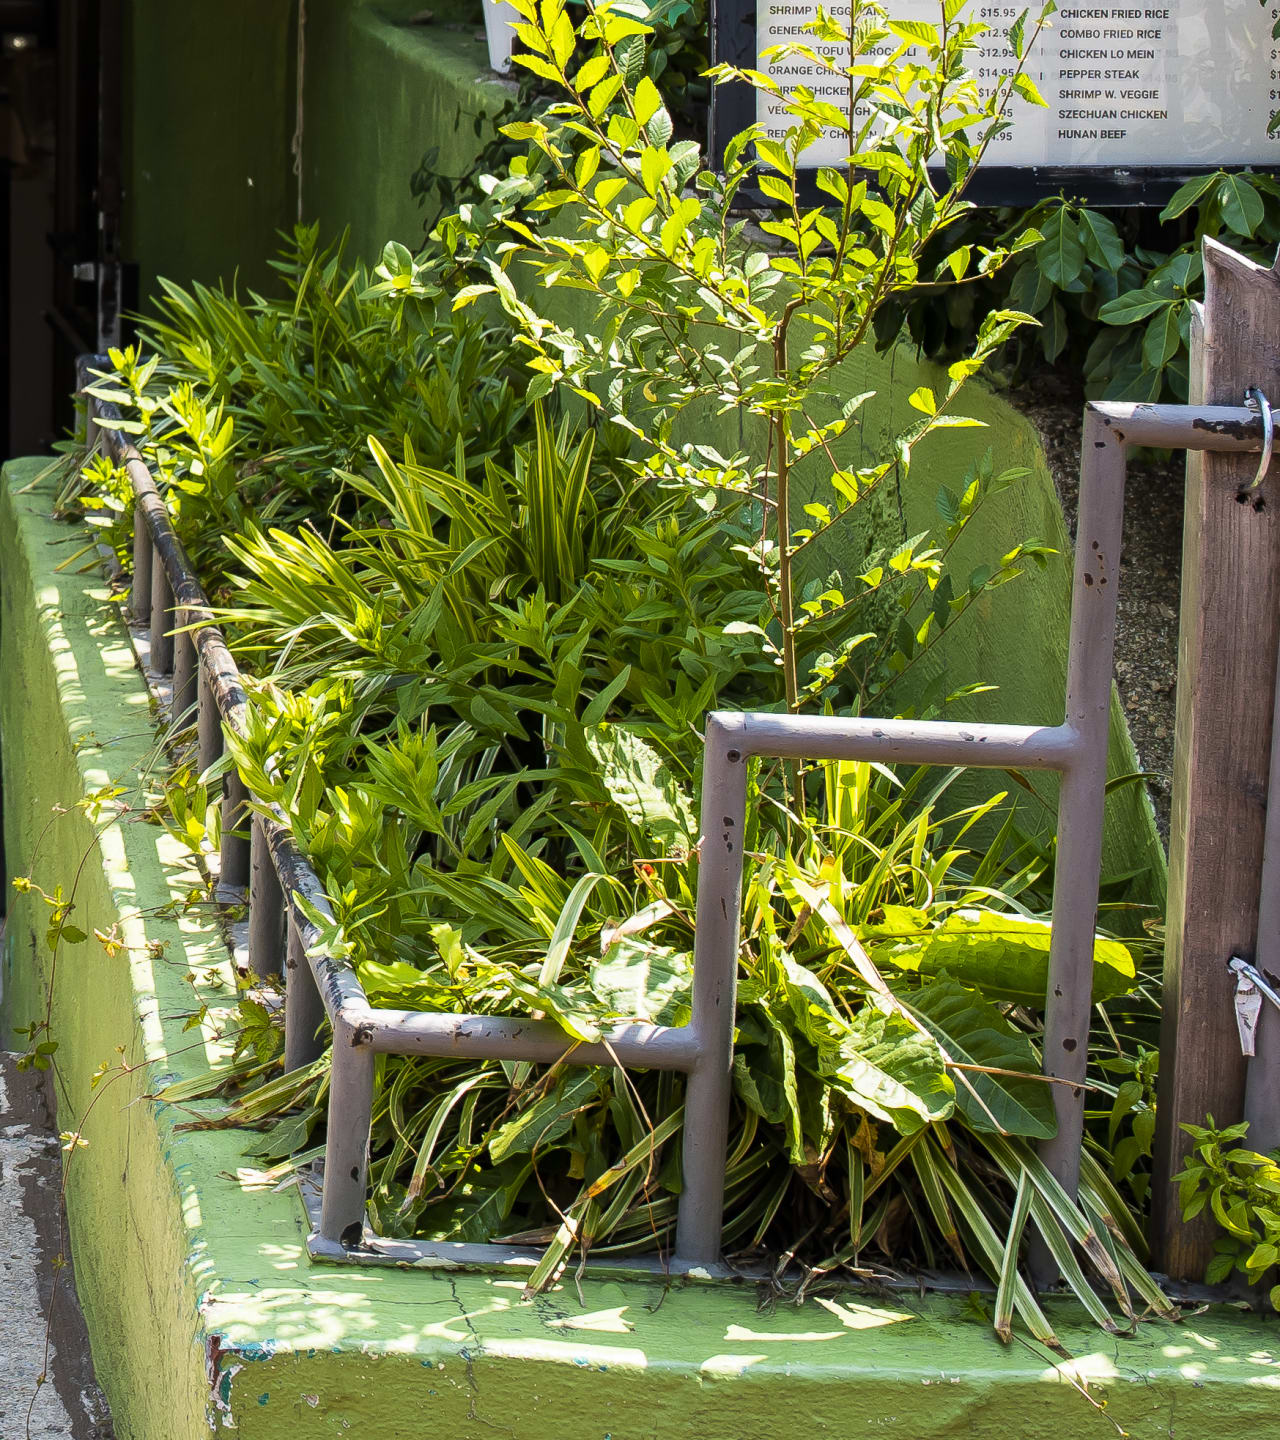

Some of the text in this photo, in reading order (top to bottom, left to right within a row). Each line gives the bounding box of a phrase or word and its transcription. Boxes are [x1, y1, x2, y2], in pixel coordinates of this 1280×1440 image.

[770, 6, 812, 15] SHRIMP
[980, 8, 1016, 18] $15.95
[1060, 10, 1169, 19] CHICKEN FRIED RICE
[1060, 30, 1161, 39] COMBO FRIED RICE
[816, 46, 844, 55] TOFU
[1060, 50, 1155, 59] CHICKEN LO MEIN
[768, 66, 813, 75] ORANGE
[979, 67, 1014, 77] $14.95
[1059, 70, 1140, 79] PEPPER STEAK
[1059, 90, 1159, 99] SHRIMP W. VEGGIE
[1058, 110, 1168, 119] SZECHUAN CHICKEN
[1058, 130, 1127, 139] HUNAN BEEF
